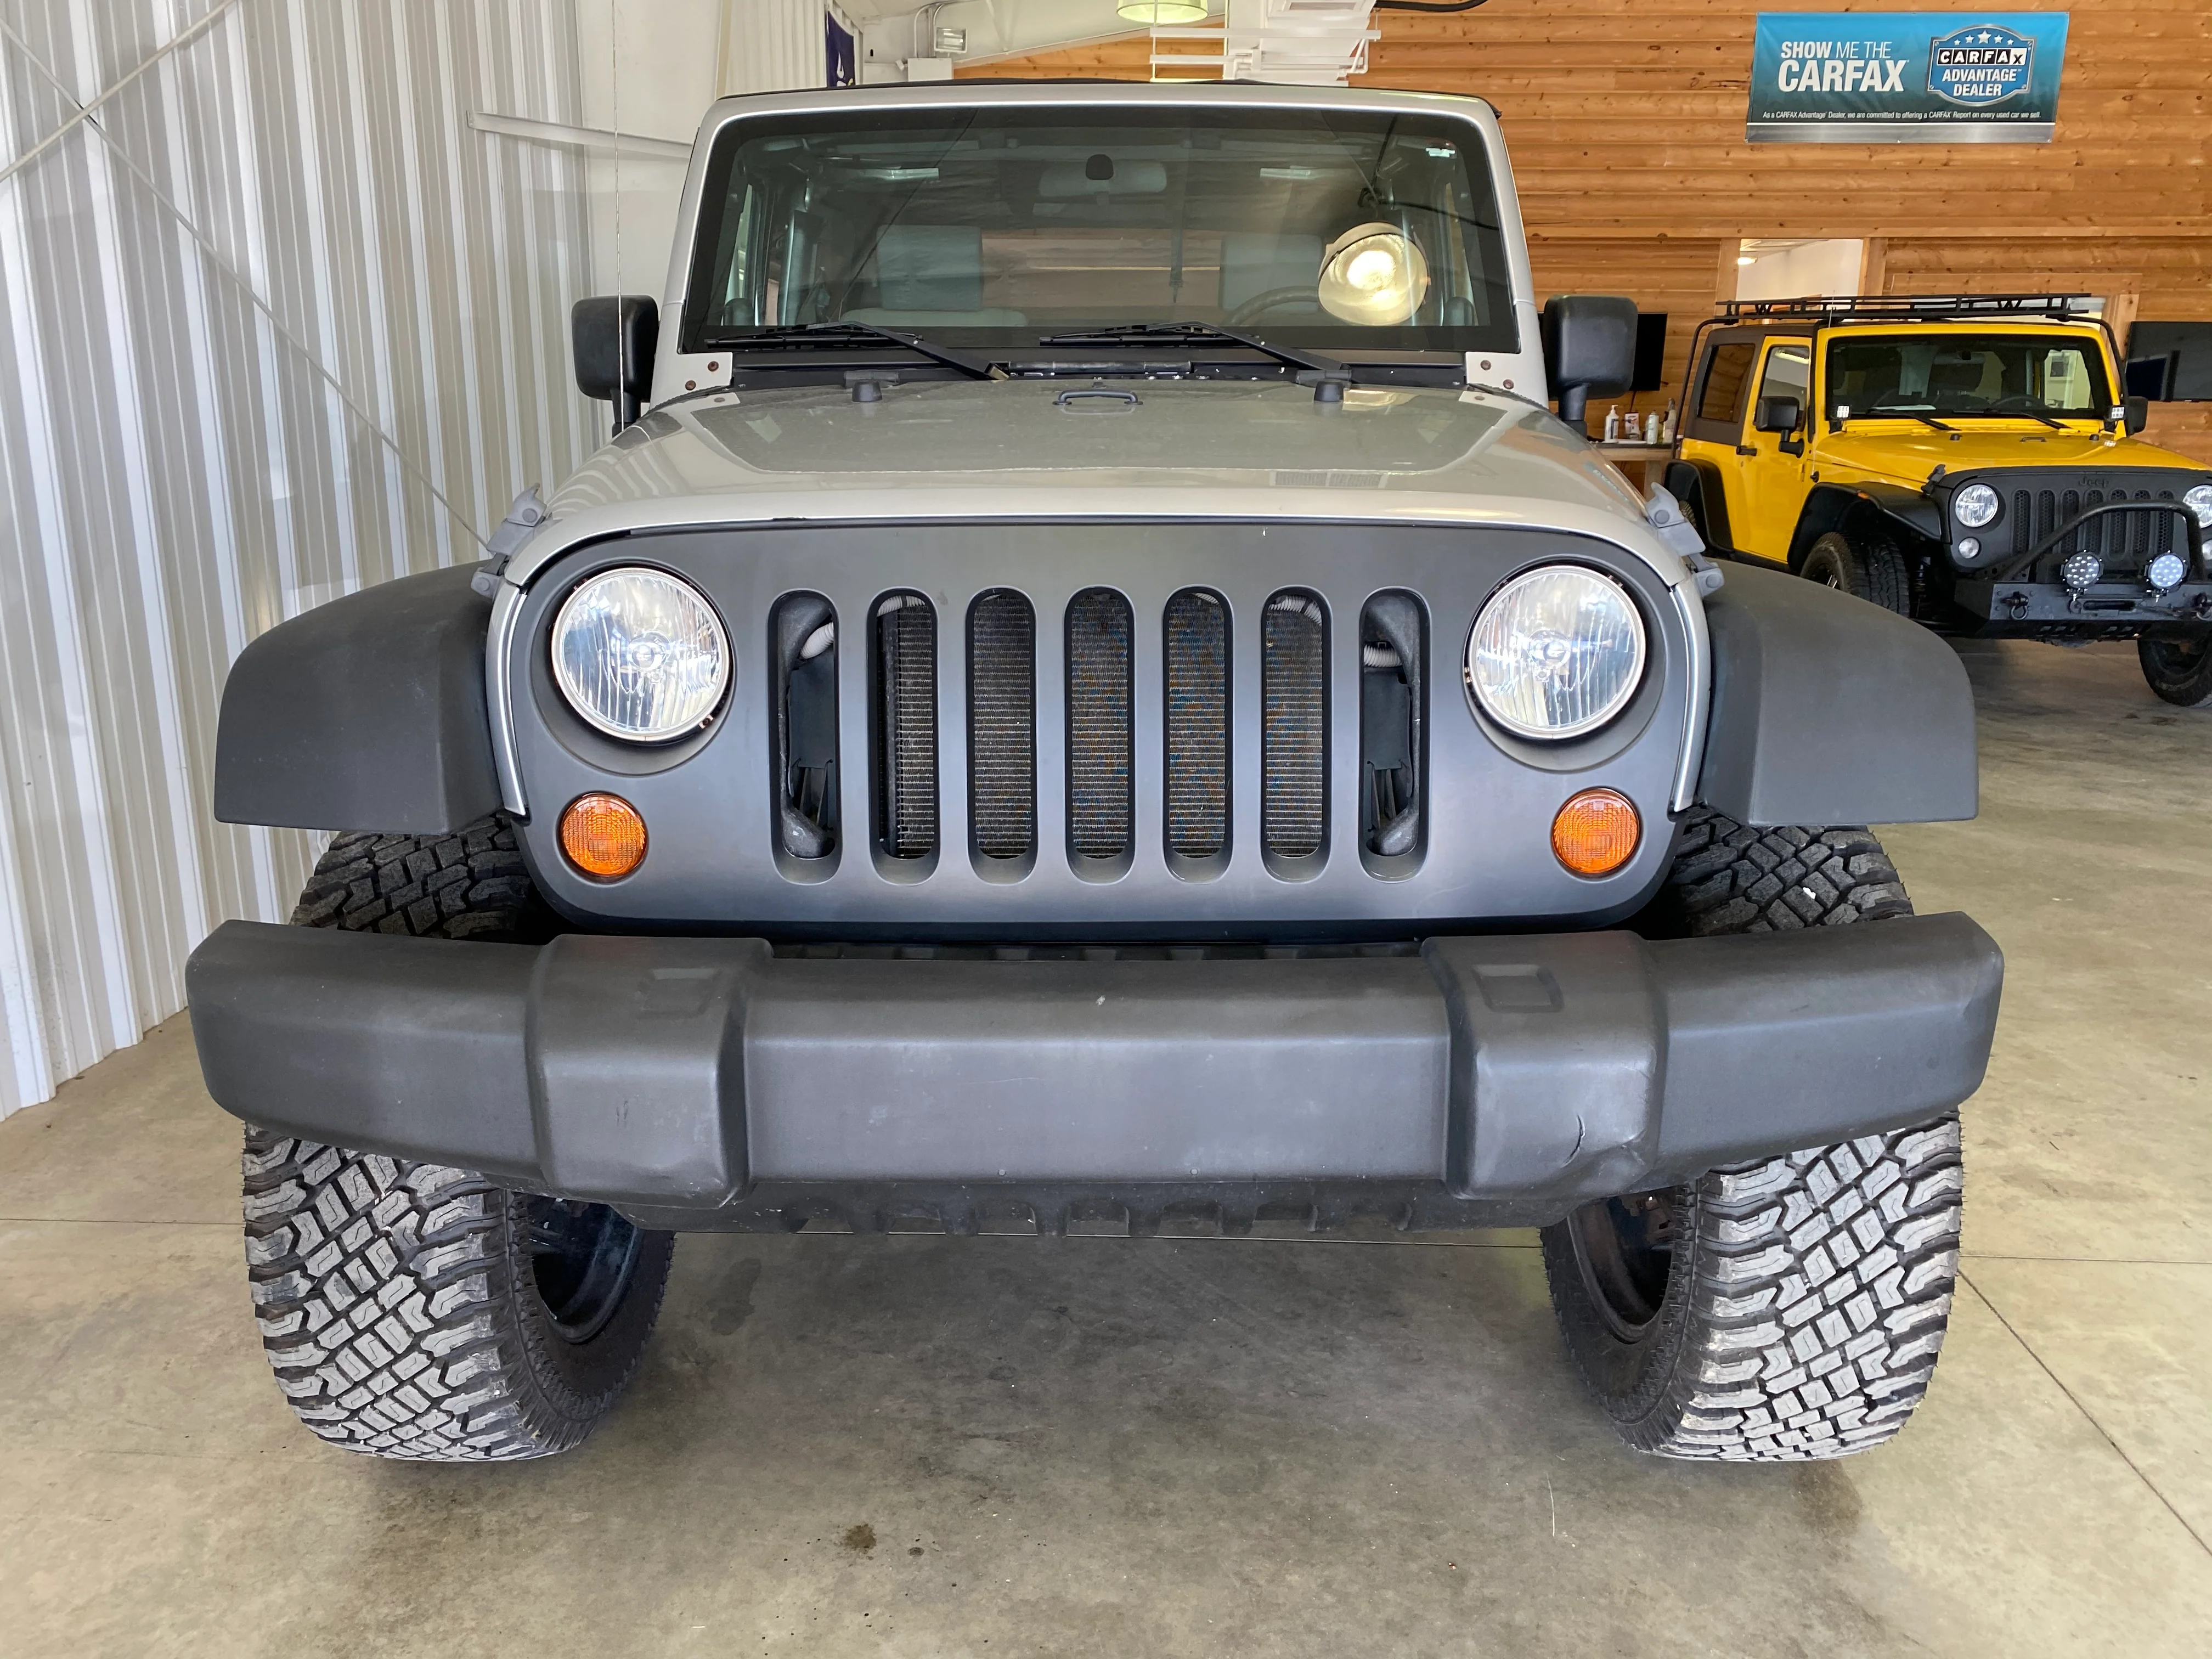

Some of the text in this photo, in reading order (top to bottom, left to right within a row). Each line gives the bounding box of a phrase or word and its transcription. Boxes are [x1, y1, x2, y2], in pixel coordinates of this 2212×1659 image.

[1781, 41, 1892, 58] SHOW ME THE
[1939, 50, 2023, 64] CARFAX
[1953, 83, 2002, 97] DEALER
[1902, 111, 1922, 120] offering
[2078, 476, 2110, 488] Jeep
